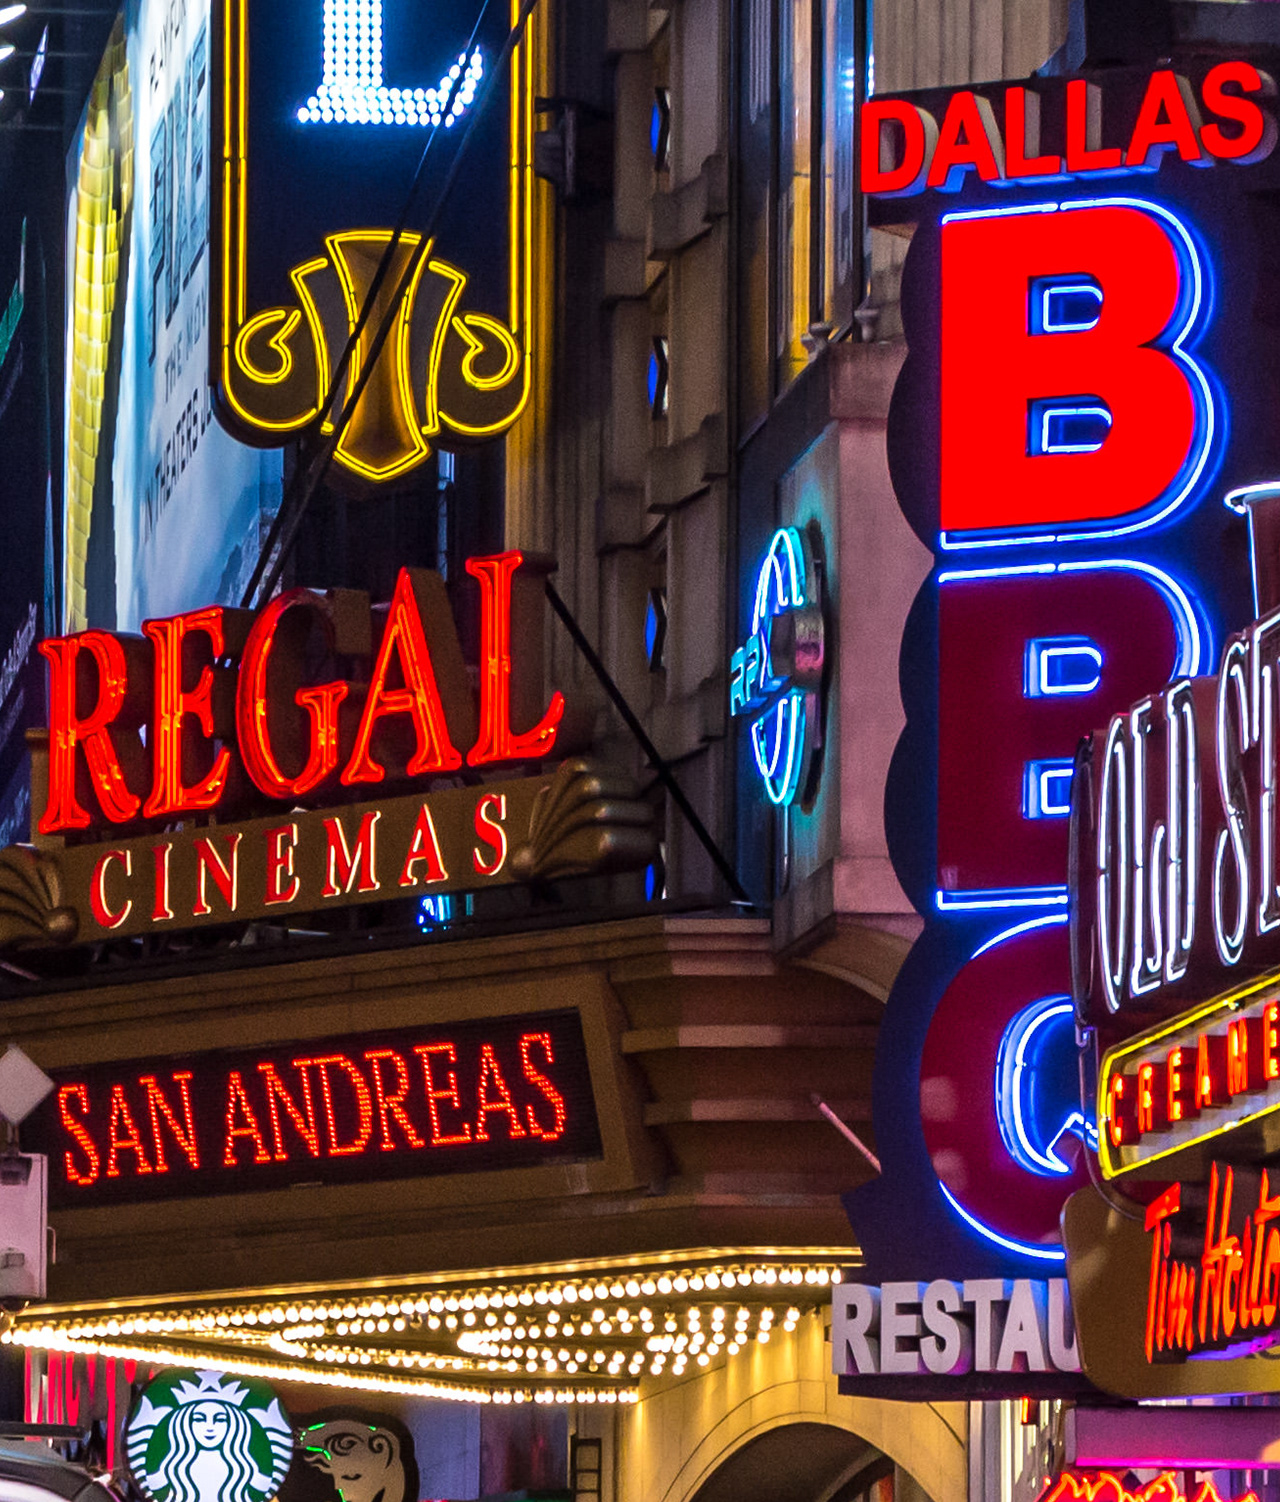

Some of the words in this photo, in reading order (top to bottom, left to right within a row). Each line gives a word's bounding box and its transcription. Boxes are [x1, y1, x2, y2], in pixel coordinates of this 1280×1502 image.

[147, 17, 209, 368] PIXE
[860, 61, 1265, 193] DALLAS
[164, 336, 183, 404] THE
[155, 387, 198, 523] THEATERS
[38, 551, 564, 835] REGAL
[90, 794, 508, 930] CINEMAS
[1098, 680, 1200, 1013] OLD
[56, 1071, 201, 1186] SAN
[223, 1031, 567, 1168] ANDREAS
